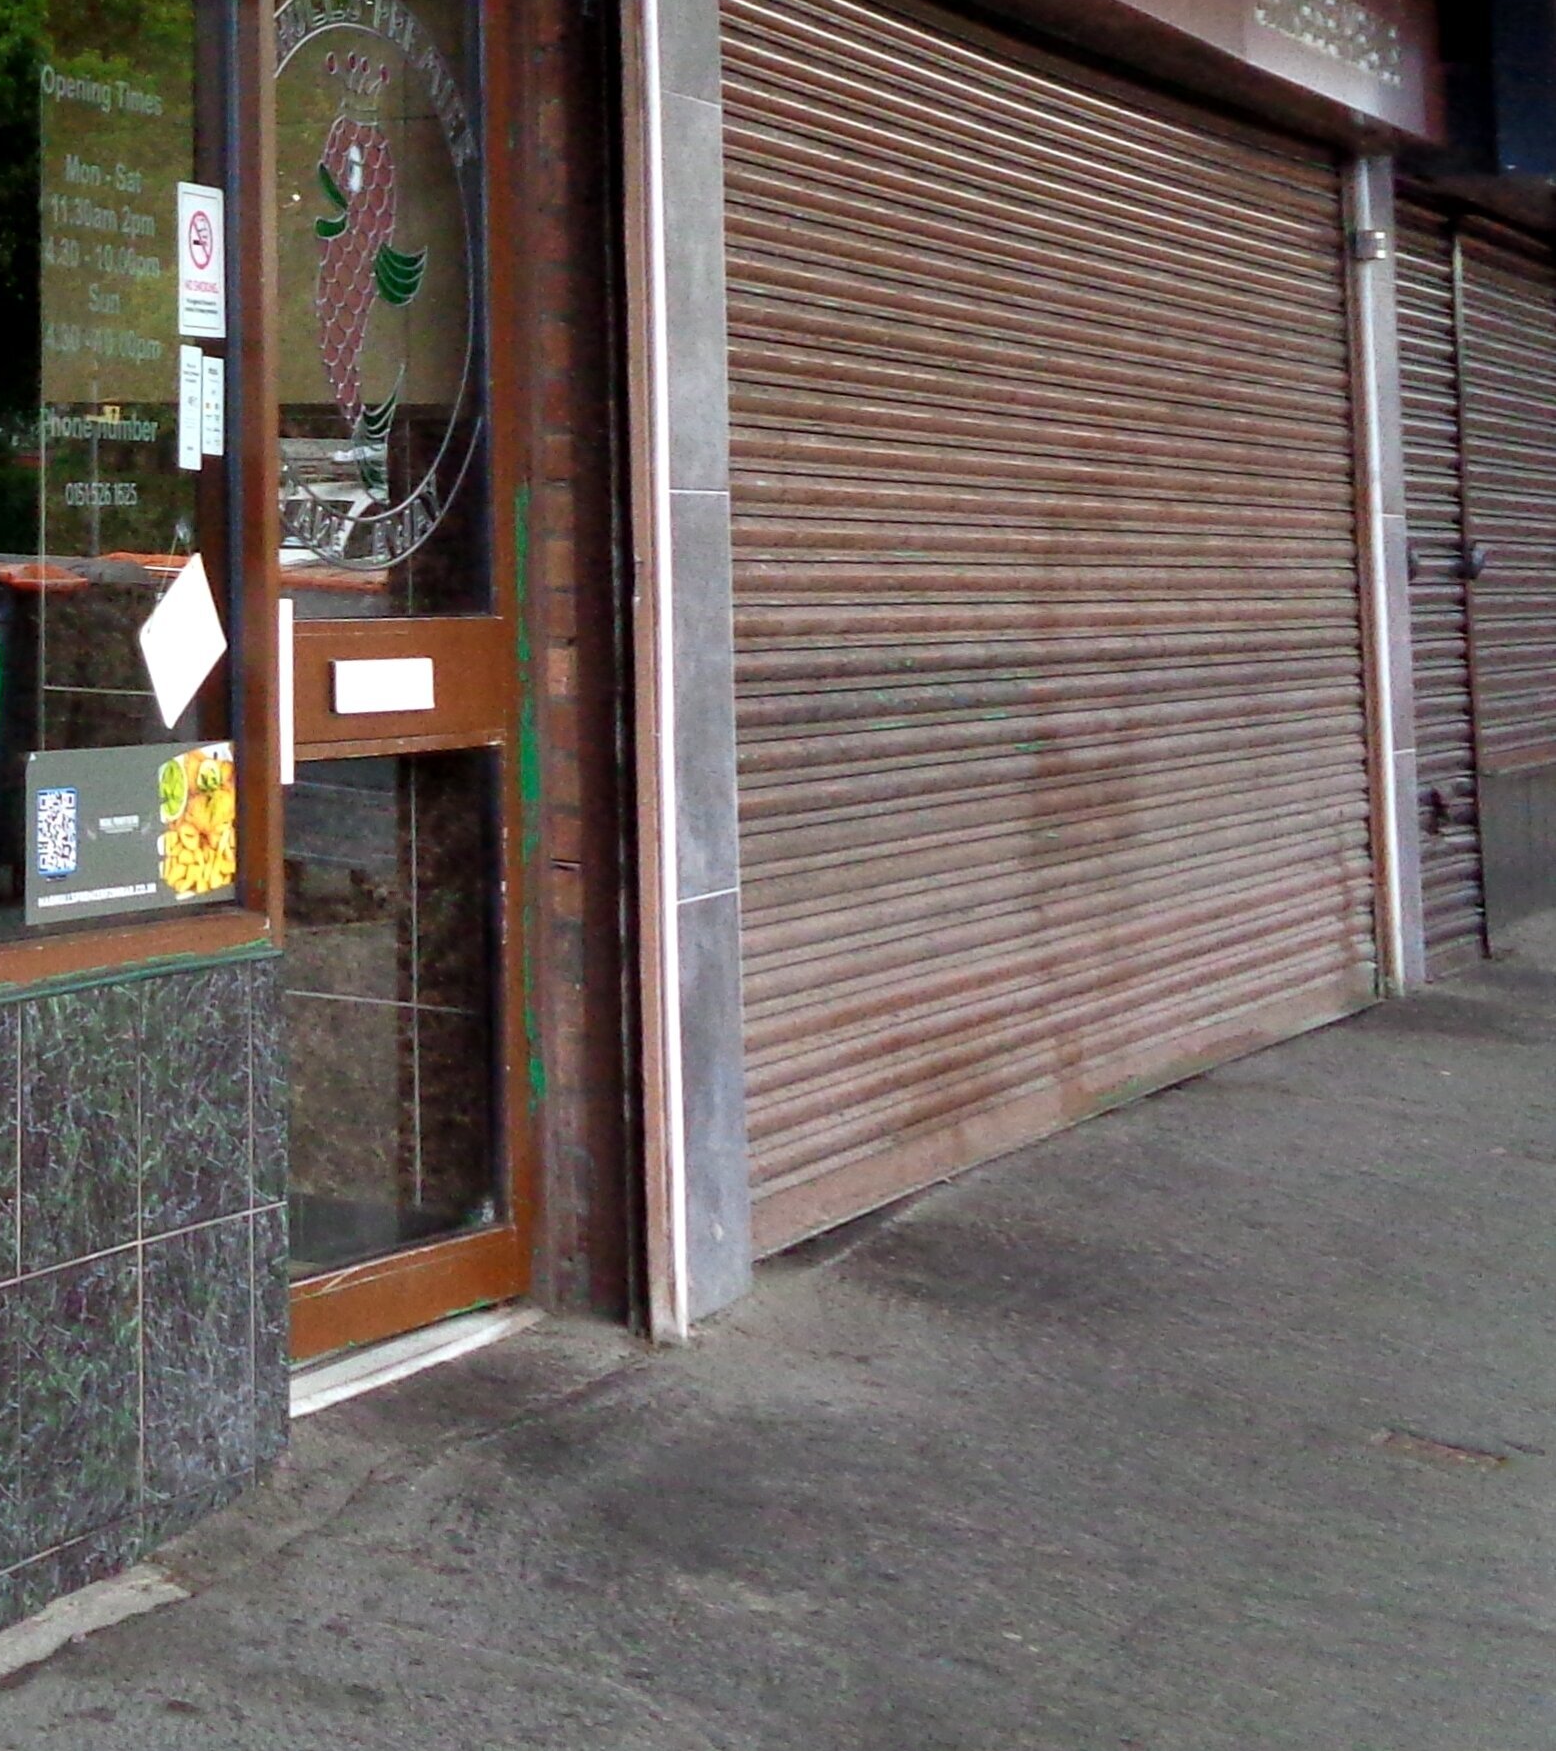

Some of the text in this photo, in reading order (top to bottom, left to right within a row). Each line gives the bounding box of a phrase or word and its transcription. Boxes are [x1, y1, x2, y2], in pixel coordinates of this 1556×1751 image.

[41, 65, 163, 116] Opening Times
[65, 153, 101, 186] Mon
[115, 163, 142, 193] Sat
[88, 282, 121, 314] Sun
[40, 407, 94, 439] Phone
